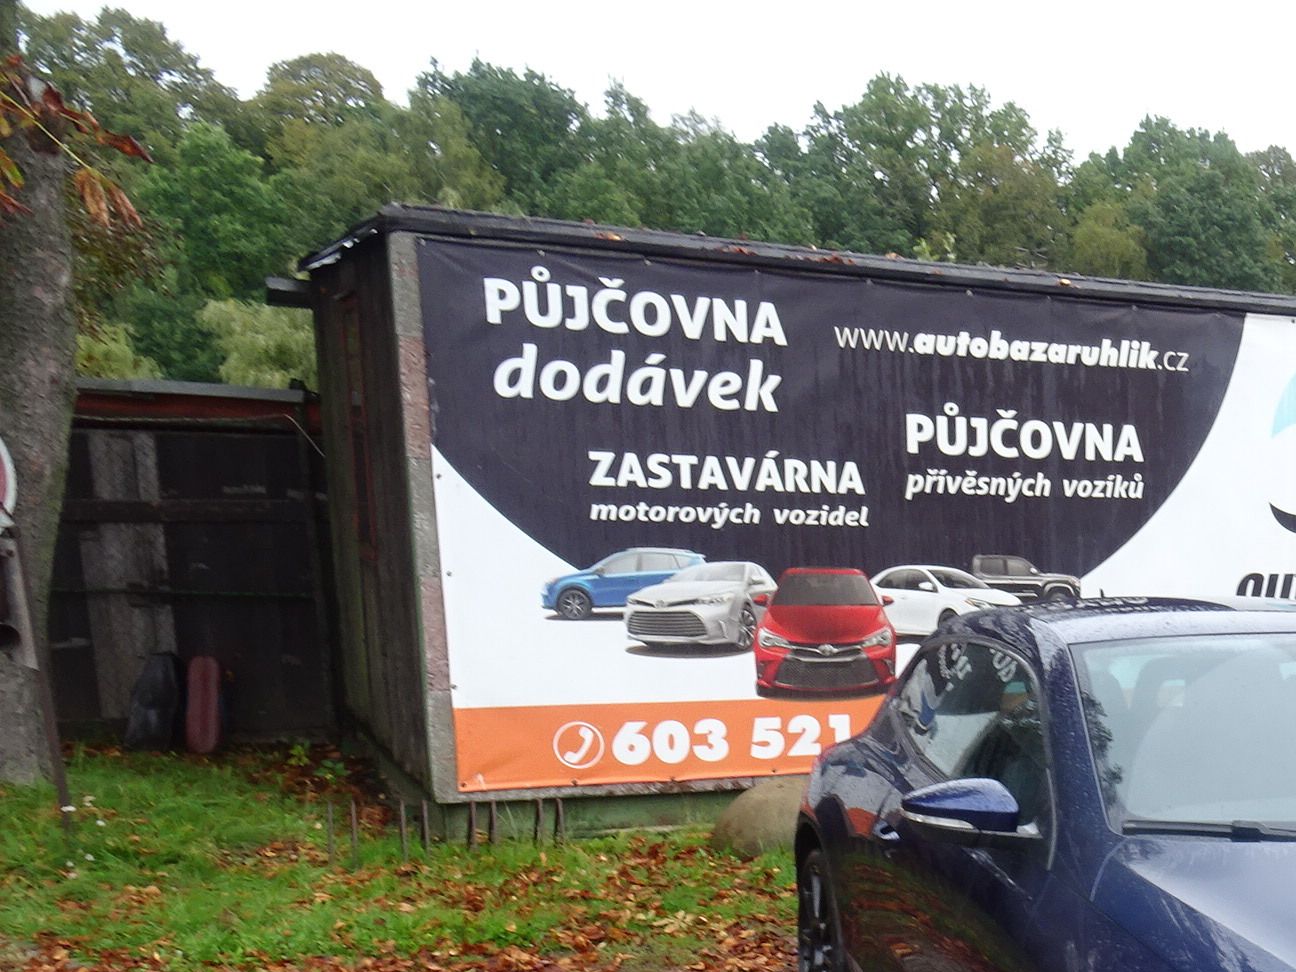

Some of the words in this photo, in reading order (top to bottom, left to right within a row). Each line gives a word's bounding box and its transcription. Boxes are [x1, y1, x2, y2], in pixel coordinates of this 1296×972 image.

[483, 265, 788, 347] PŮJČOVNA
[834, 325, 1191, 372] www.autobazaruhlik.cz
[493, 342, 783, 412] dodávek
[905, 402, 1145, 463] PŮJČOVNA
[587, 450, 867, 496] ZASTAVÁRNA
[904, 467, 1051, 504] přívěsných
[1062, 472, 1145, 500] vozíků
[589, 501, 761, 531] motorových
[773, 504, 870, 528] vozidel
[611, 717, 729, 766] 603
[749, 713, 852, 760] 521
